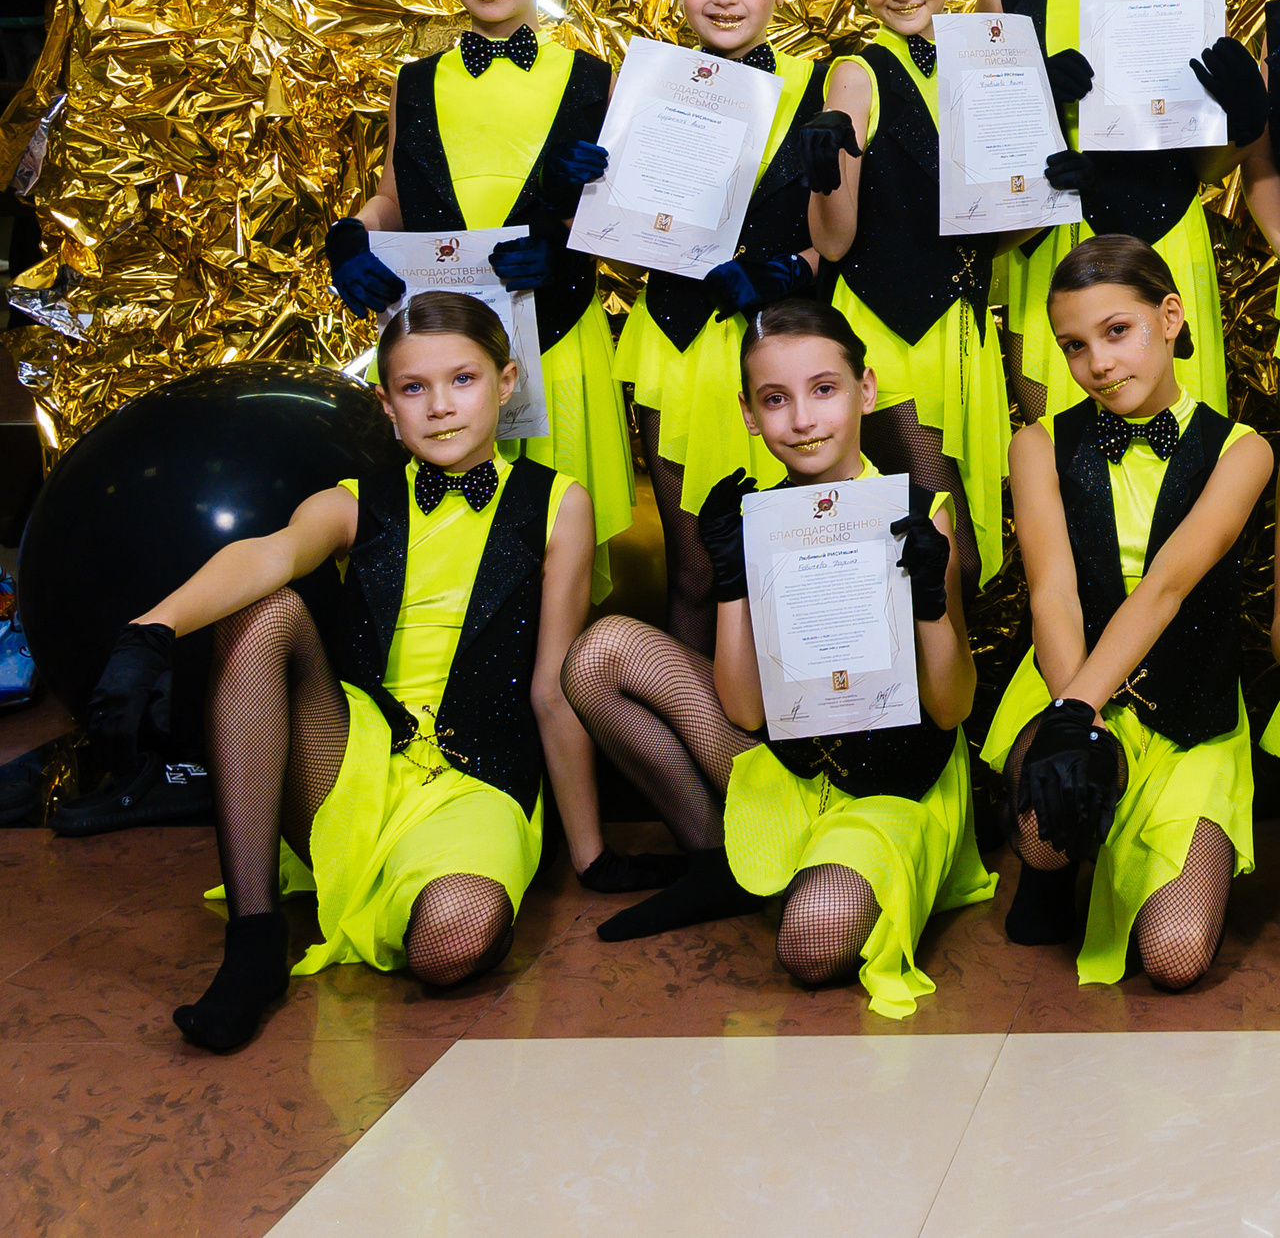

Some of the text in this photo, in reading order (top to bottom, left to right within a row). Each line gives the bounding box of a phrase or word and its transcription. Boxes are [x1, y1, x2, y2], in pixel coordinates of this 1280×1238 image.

[985, 57, 1018, 66] ПИСЬМО
[672, 92, 720, 112] ПИСЬМО
[427, 275, 475, 285] ПИСЬМО
[769, 517, 884, 541] БЛАГОДАРСТВЕННОЕ
[802, 532, 851, 547] ПИСЬМО
